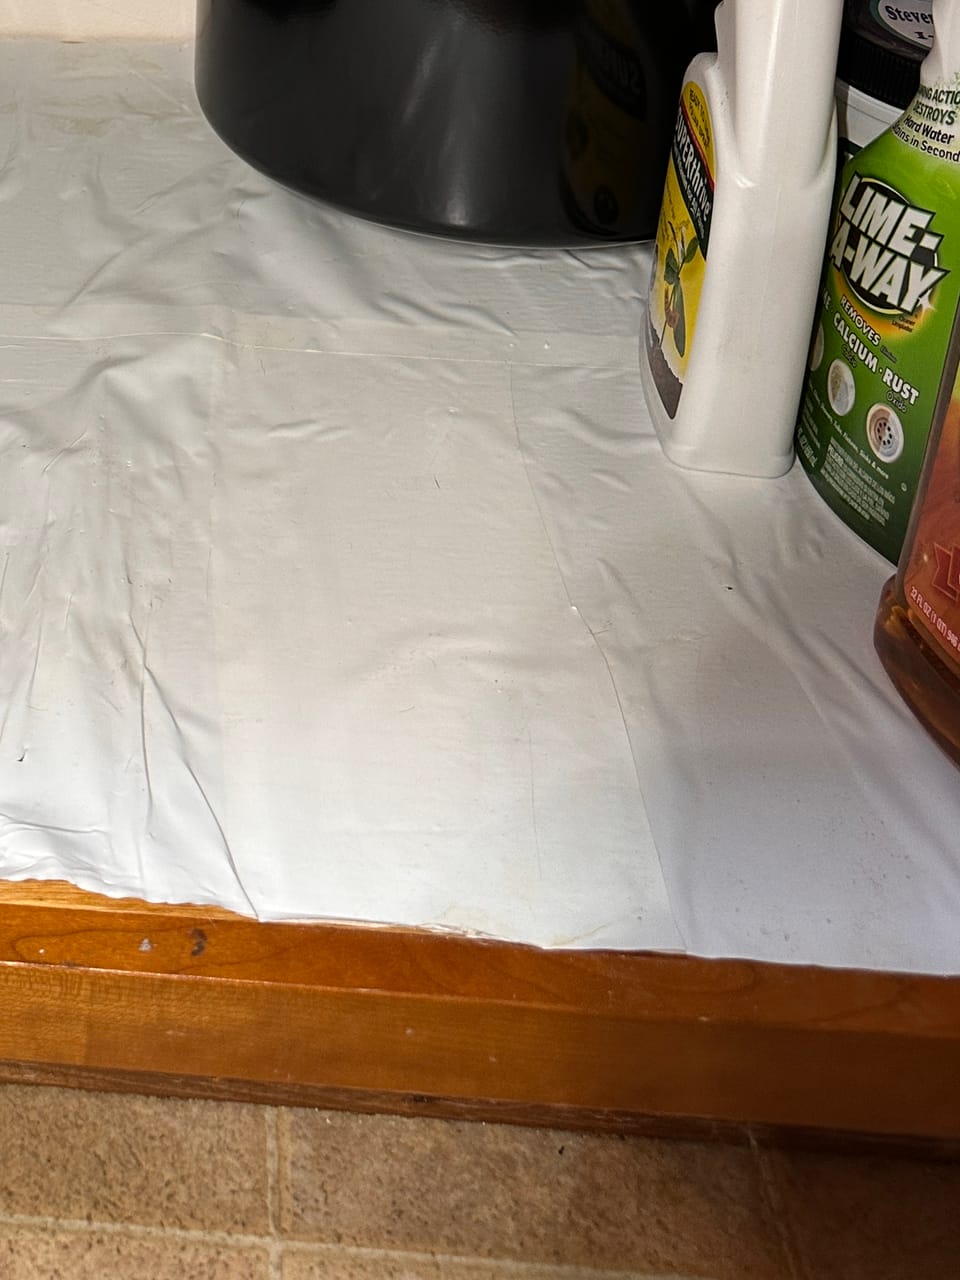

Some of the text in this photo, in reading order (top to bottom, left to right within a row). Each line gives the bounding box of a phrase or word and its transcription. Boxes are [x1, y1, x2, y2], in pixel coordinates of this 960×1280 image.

[903, 114, 955, 145] Hard Water
[913, 100, 956, 126] DESTROYS
[911, 134, 920, 148] in
[841, 172, 942, 258] LIME-
[831, 219, 949, 313] A-WAY
[840, 296, 881, 346] REMOVES
[833, 312, 879, 373] CALCIUM
[882, 368, 920, 405] RUST
